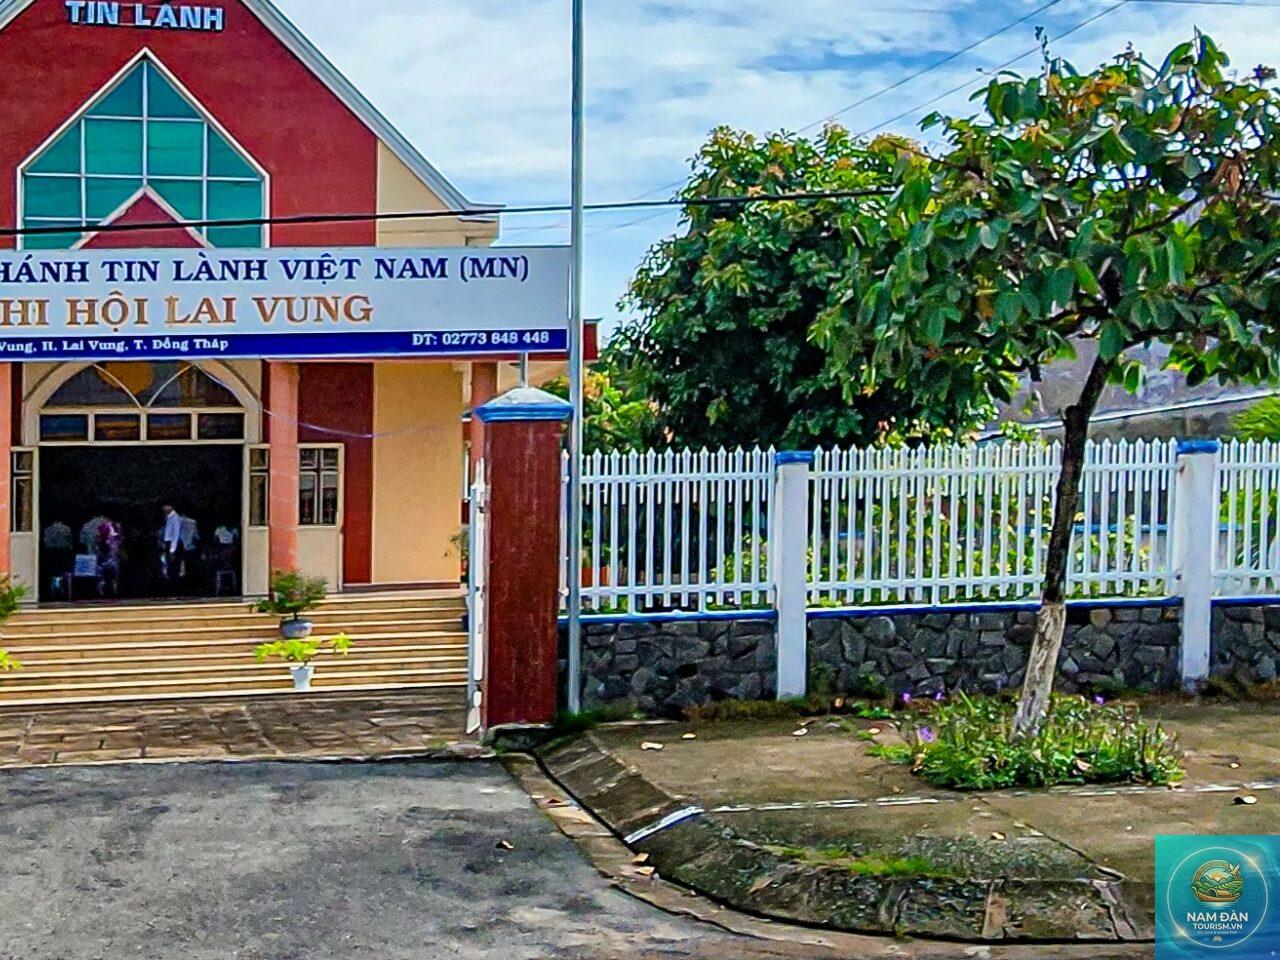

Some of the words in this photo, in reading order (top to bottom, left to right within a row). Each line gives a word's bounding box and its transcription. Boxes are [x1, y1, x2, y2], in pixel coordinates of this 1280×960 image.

[65, 0, 118, 24] TIN
[101, 259, 161, 282] TIN
[173, 252, 268, 282] LÀNH
[278, 253, 361, 284] VIỆT
[374, 257, 449, 279] NAM
[459, 255, 530, 282] (MN)
[65, 289, 149, 333] HỘI
[164, 295, 238, 325] LAI
[251, 295, 374, 323] VUNG
[63, 340, 84, 351] Lai
[133, 339, 148, 350] T.
[193, 338, 229, 351] Tháp
[442, 332, 487, 345] 02773
[491, 332, 518, 344] 848
[522, 331, 550, 343] 448
